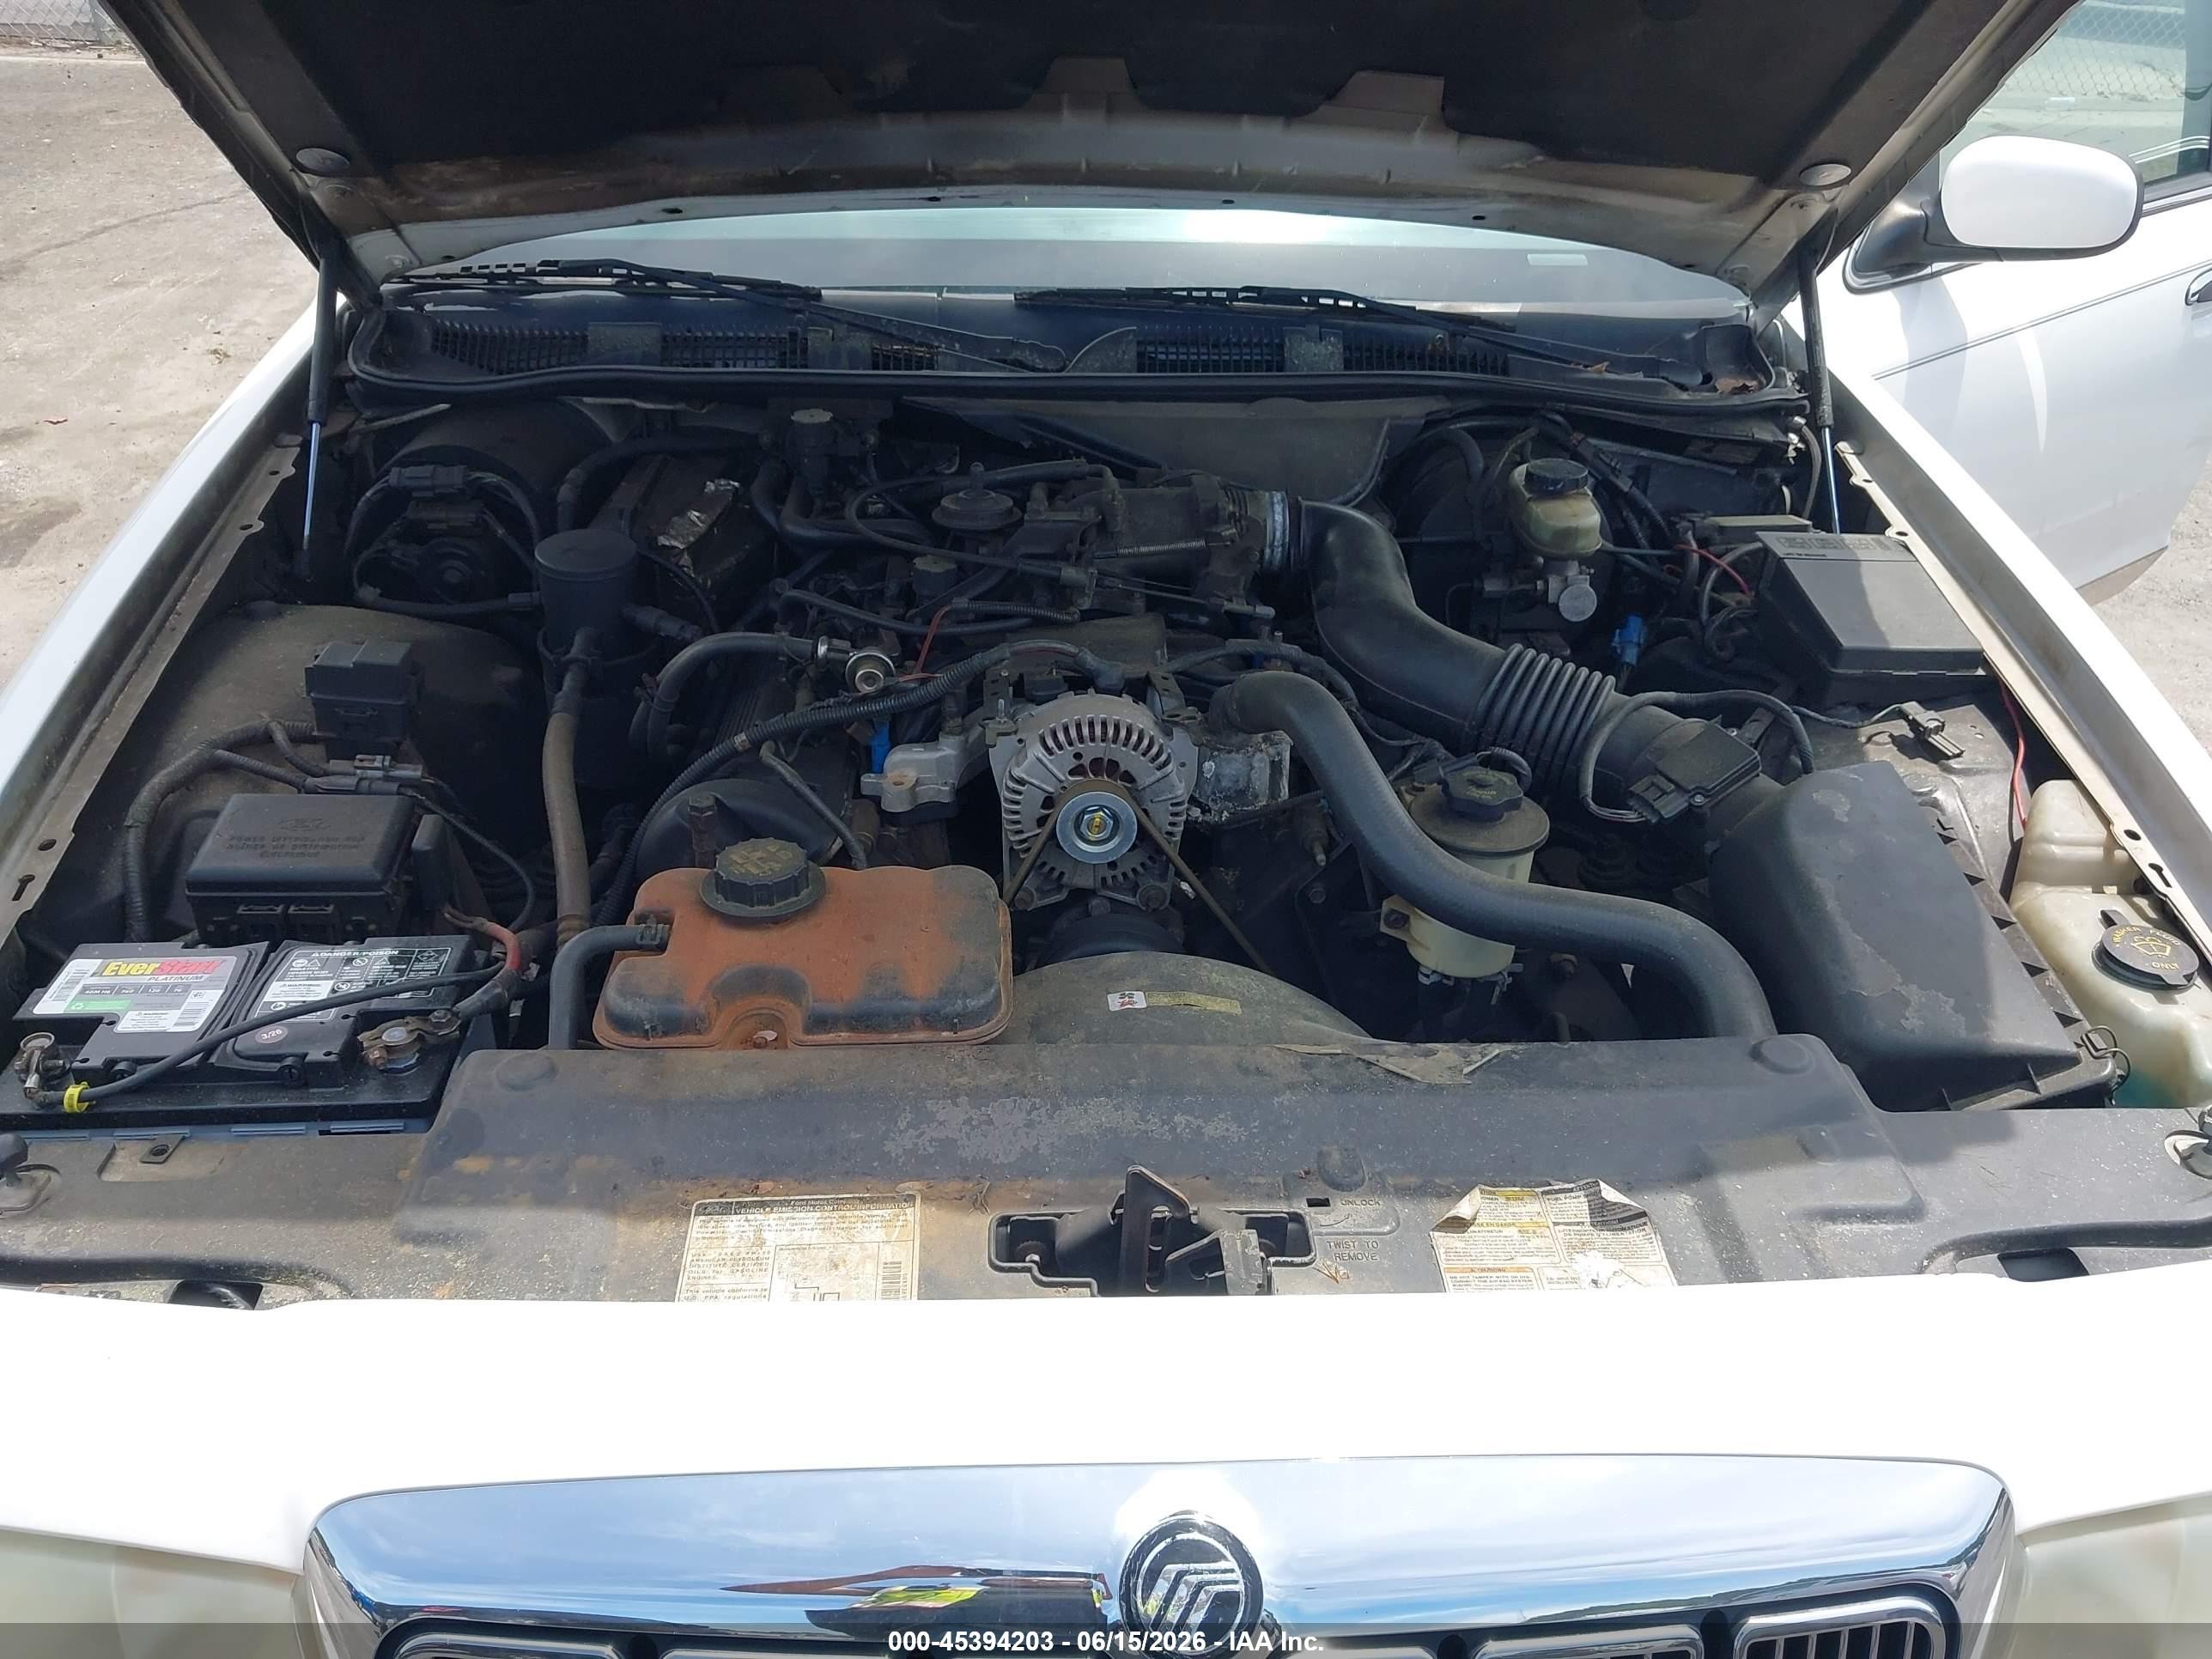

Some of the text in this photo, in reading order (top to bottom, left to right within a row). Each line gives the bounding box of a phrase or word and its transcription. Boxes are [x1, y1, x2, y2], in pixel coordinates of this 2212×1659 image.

[2112, 927, 2182, 945] WASHER FLUID
[102, 960, 222, 977] EverStart
[2151, 962, 2179, 970] ONLY
[773, 1204, 813, 1213] EMISSION
[815, 1203, 856, 1212] CONTROL
[1327, 1240, 1379, 1249] TWIST TO
[1334, 1252, 1378, 1261] REMOVE
